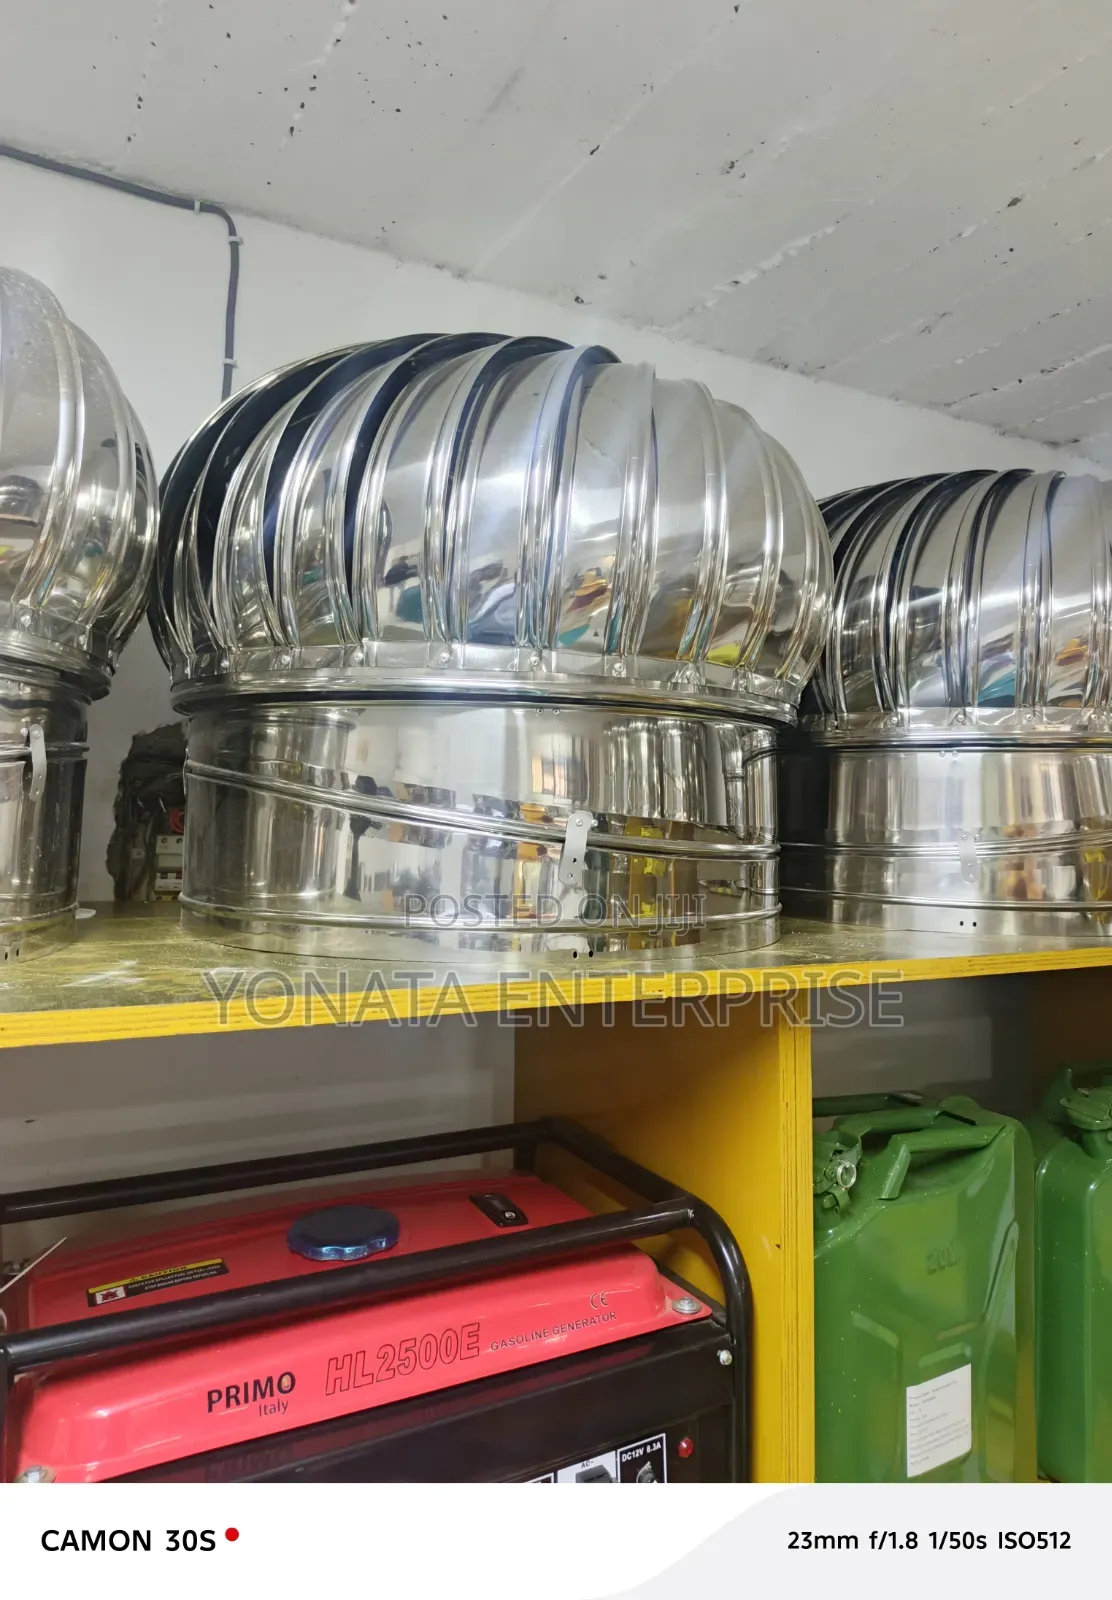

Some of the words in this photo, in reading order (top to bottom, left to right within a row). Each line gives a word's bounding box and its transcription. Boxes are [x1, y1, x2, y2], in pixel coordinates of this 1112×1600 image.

[590, 1291, 608, 1309] CE
[490, 1328, 549, 1351] GASOLINE
[552, 1312, 617, 1336] GENERATOR
[325, 1322, 480, 1396] HL2500E
[207, 1371, 296, 1413] PRIMO
[259, 1398, 289, 1417] Italy
[621, 1447, 644, 1463] DC12V
[646, 1441, 661, 1453] 8.3A
